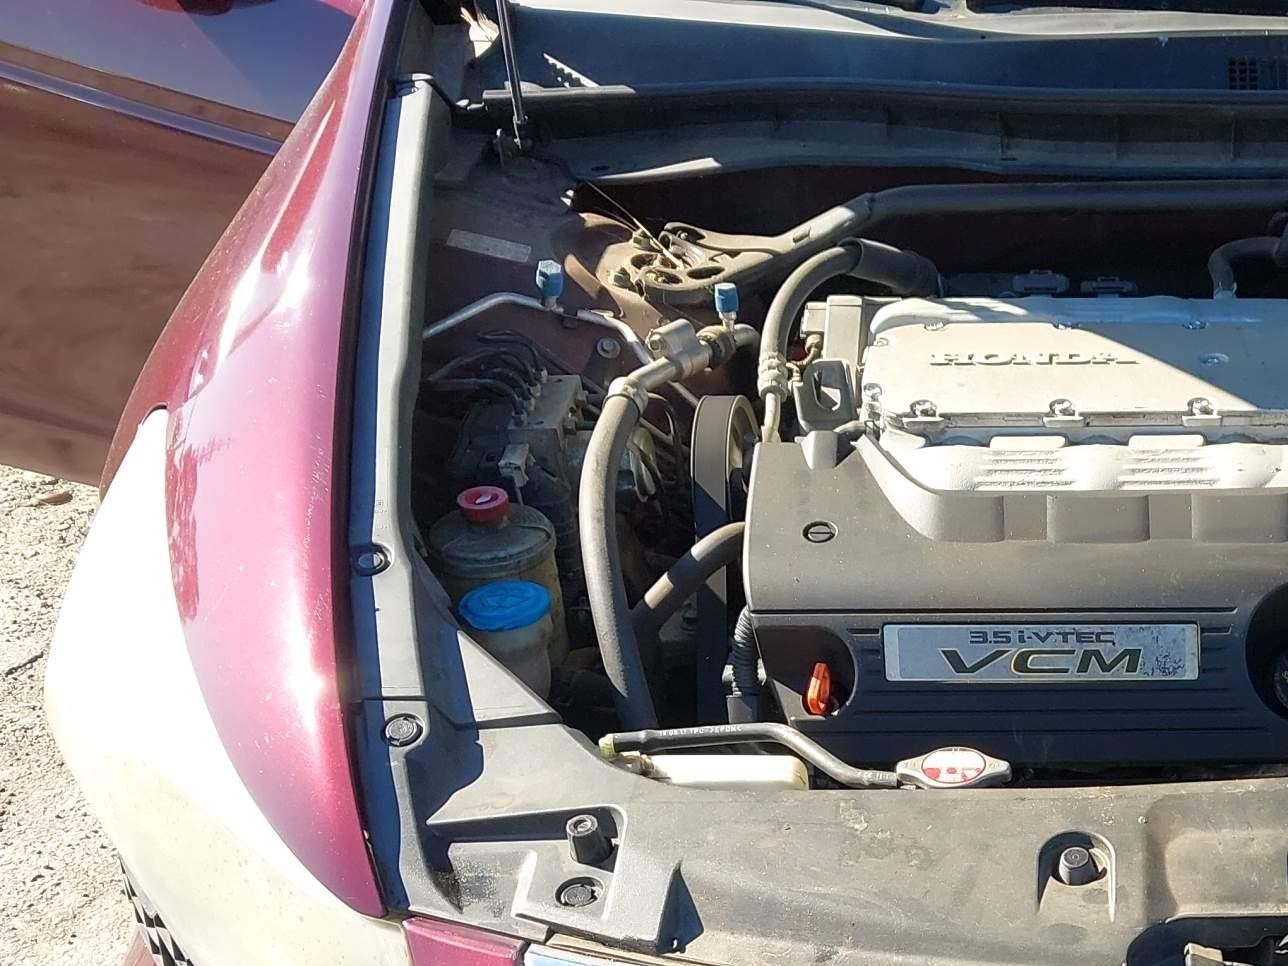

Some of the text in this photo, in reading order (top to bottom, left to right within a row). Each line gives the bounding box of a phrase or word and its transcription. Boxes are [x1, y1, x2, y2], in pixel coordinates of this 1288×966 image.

[930, 351, 1140, 366] HONDA
[969, 631, 1116, 646] 3.5 i-VTEC
[938, 648, 1144, 675] VCM
